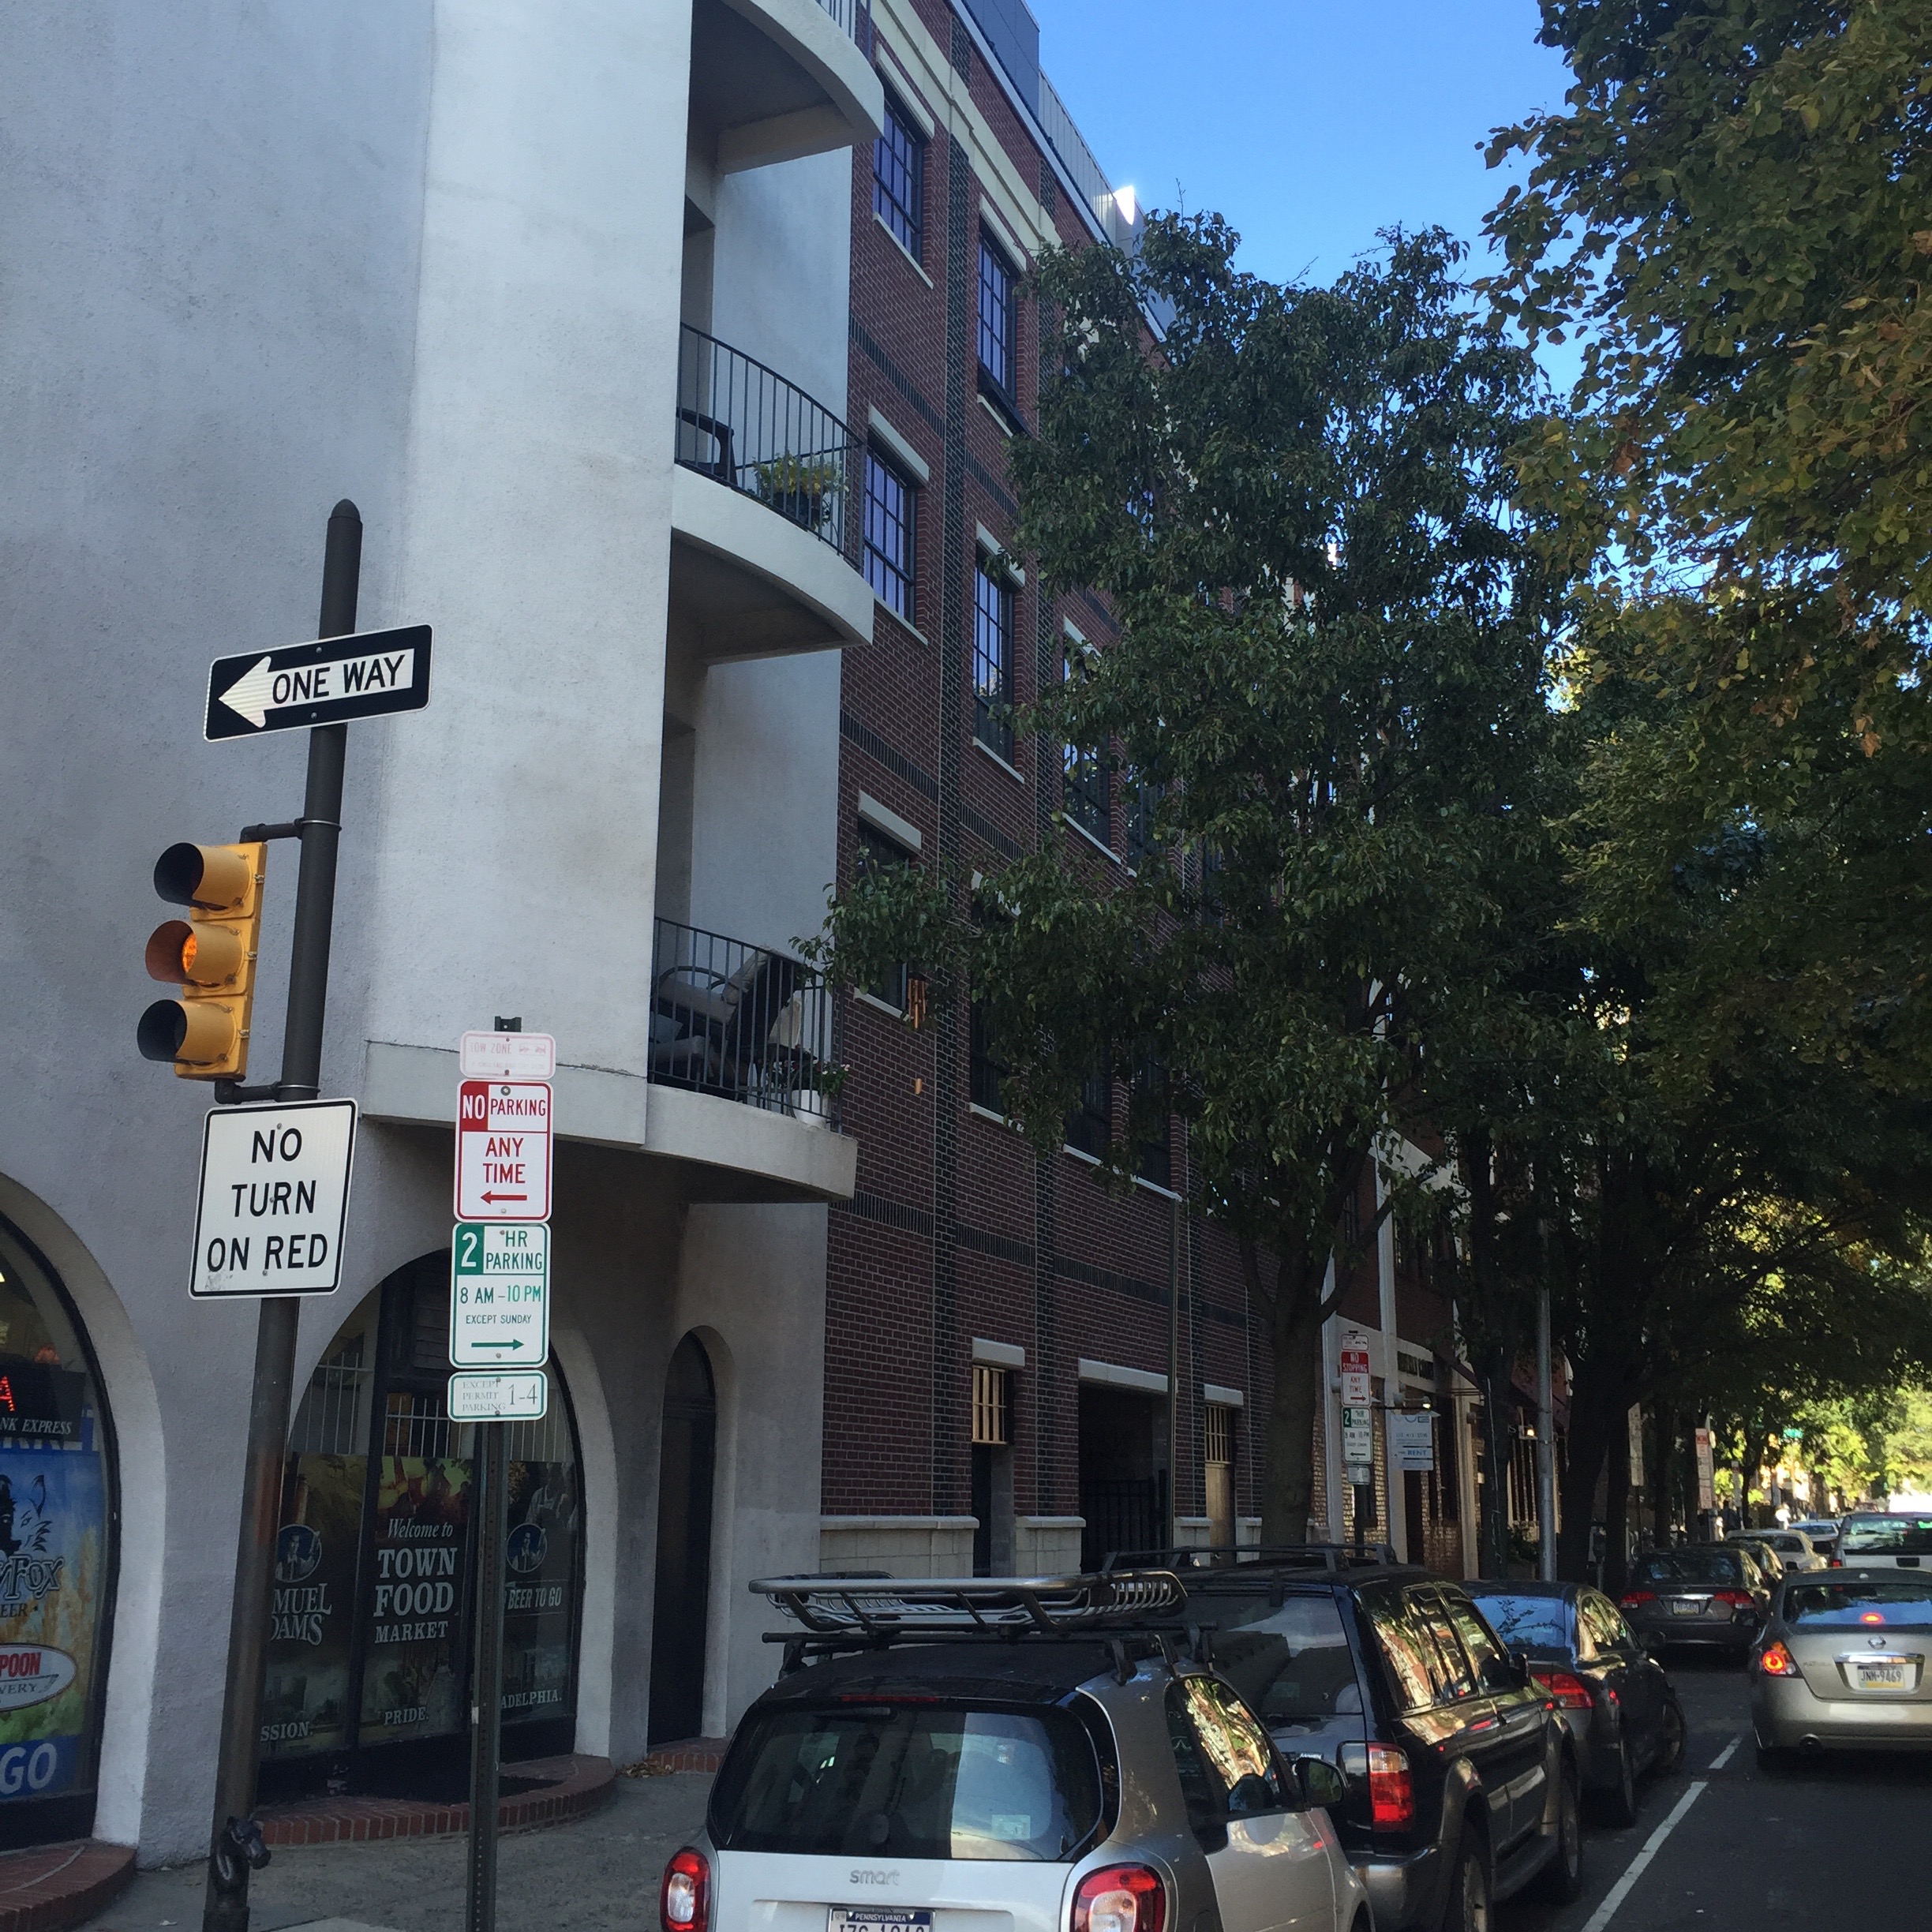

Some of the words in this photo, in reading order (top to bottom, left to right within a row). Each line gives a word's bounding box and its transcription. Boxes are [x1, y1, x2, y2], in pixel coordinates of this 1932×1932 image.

[272, 667, 331, 705] ONE
[343, 654, 406, 694] WAY
[491, 1043, 512, 1054] ZONE
[462, 1094, 485, 1120] NO
[490, 1098, 546, 1117] PARKING
[252, 1128, 302, 1164] NO
[485, 1136, 524, 1158] ANY
[482, 1163, 526, 1184] TIME
[231, 1180, 316, 1217] TURN
[207, 1237, 249, 1272] ON
[264, 1234, 328, 1270] RED
[461, 1232, 477, 1267] 2
[505, 1230, 528, 1248] HR
[485, 1252, 543, 1271] PARKING
[460, 1286, 468, 1305] 8
[474, 1287, 494, 1304] AM
[524, 1285, 541, 1302] PM
[466, 1314, 496, 1324] EXCEPT
[500, 1314, 532, 1324] SUNDAY
[1342, 1362, 1368, 1373] STOPPING
[1350, 1352, 1360, 1364] NO
[462, 1380, 500, 1389] EXCEPT
[508, 1383, 538, 1406] 1-4
[462, 1391, 500, 1400] PERMIT
[462, 1402, 506, 1412] PARKING
[21, 1418, 73, 1436] EXPRESS
[1344, 1410, 1350, 1425] 2
[388, 1518, 439, 1538] Welcome
[441, 1522, 453, 1537] to
[377, 1547, 459, 1578] TOWN
[373, 1582, 454, 1618] FOOD
[507, 1588, 533, 1610] BEER
[535, 1587, 548, 1608] TO
[549, 1586, 563, 1608] GO
[374, 1620, 448, 1644] MARKET
[0, 1743, 57, 1795] GO
[849, 1868, 900, 1886] smart
[855, 1912, 907, 1923] PENNSYLVANIA
